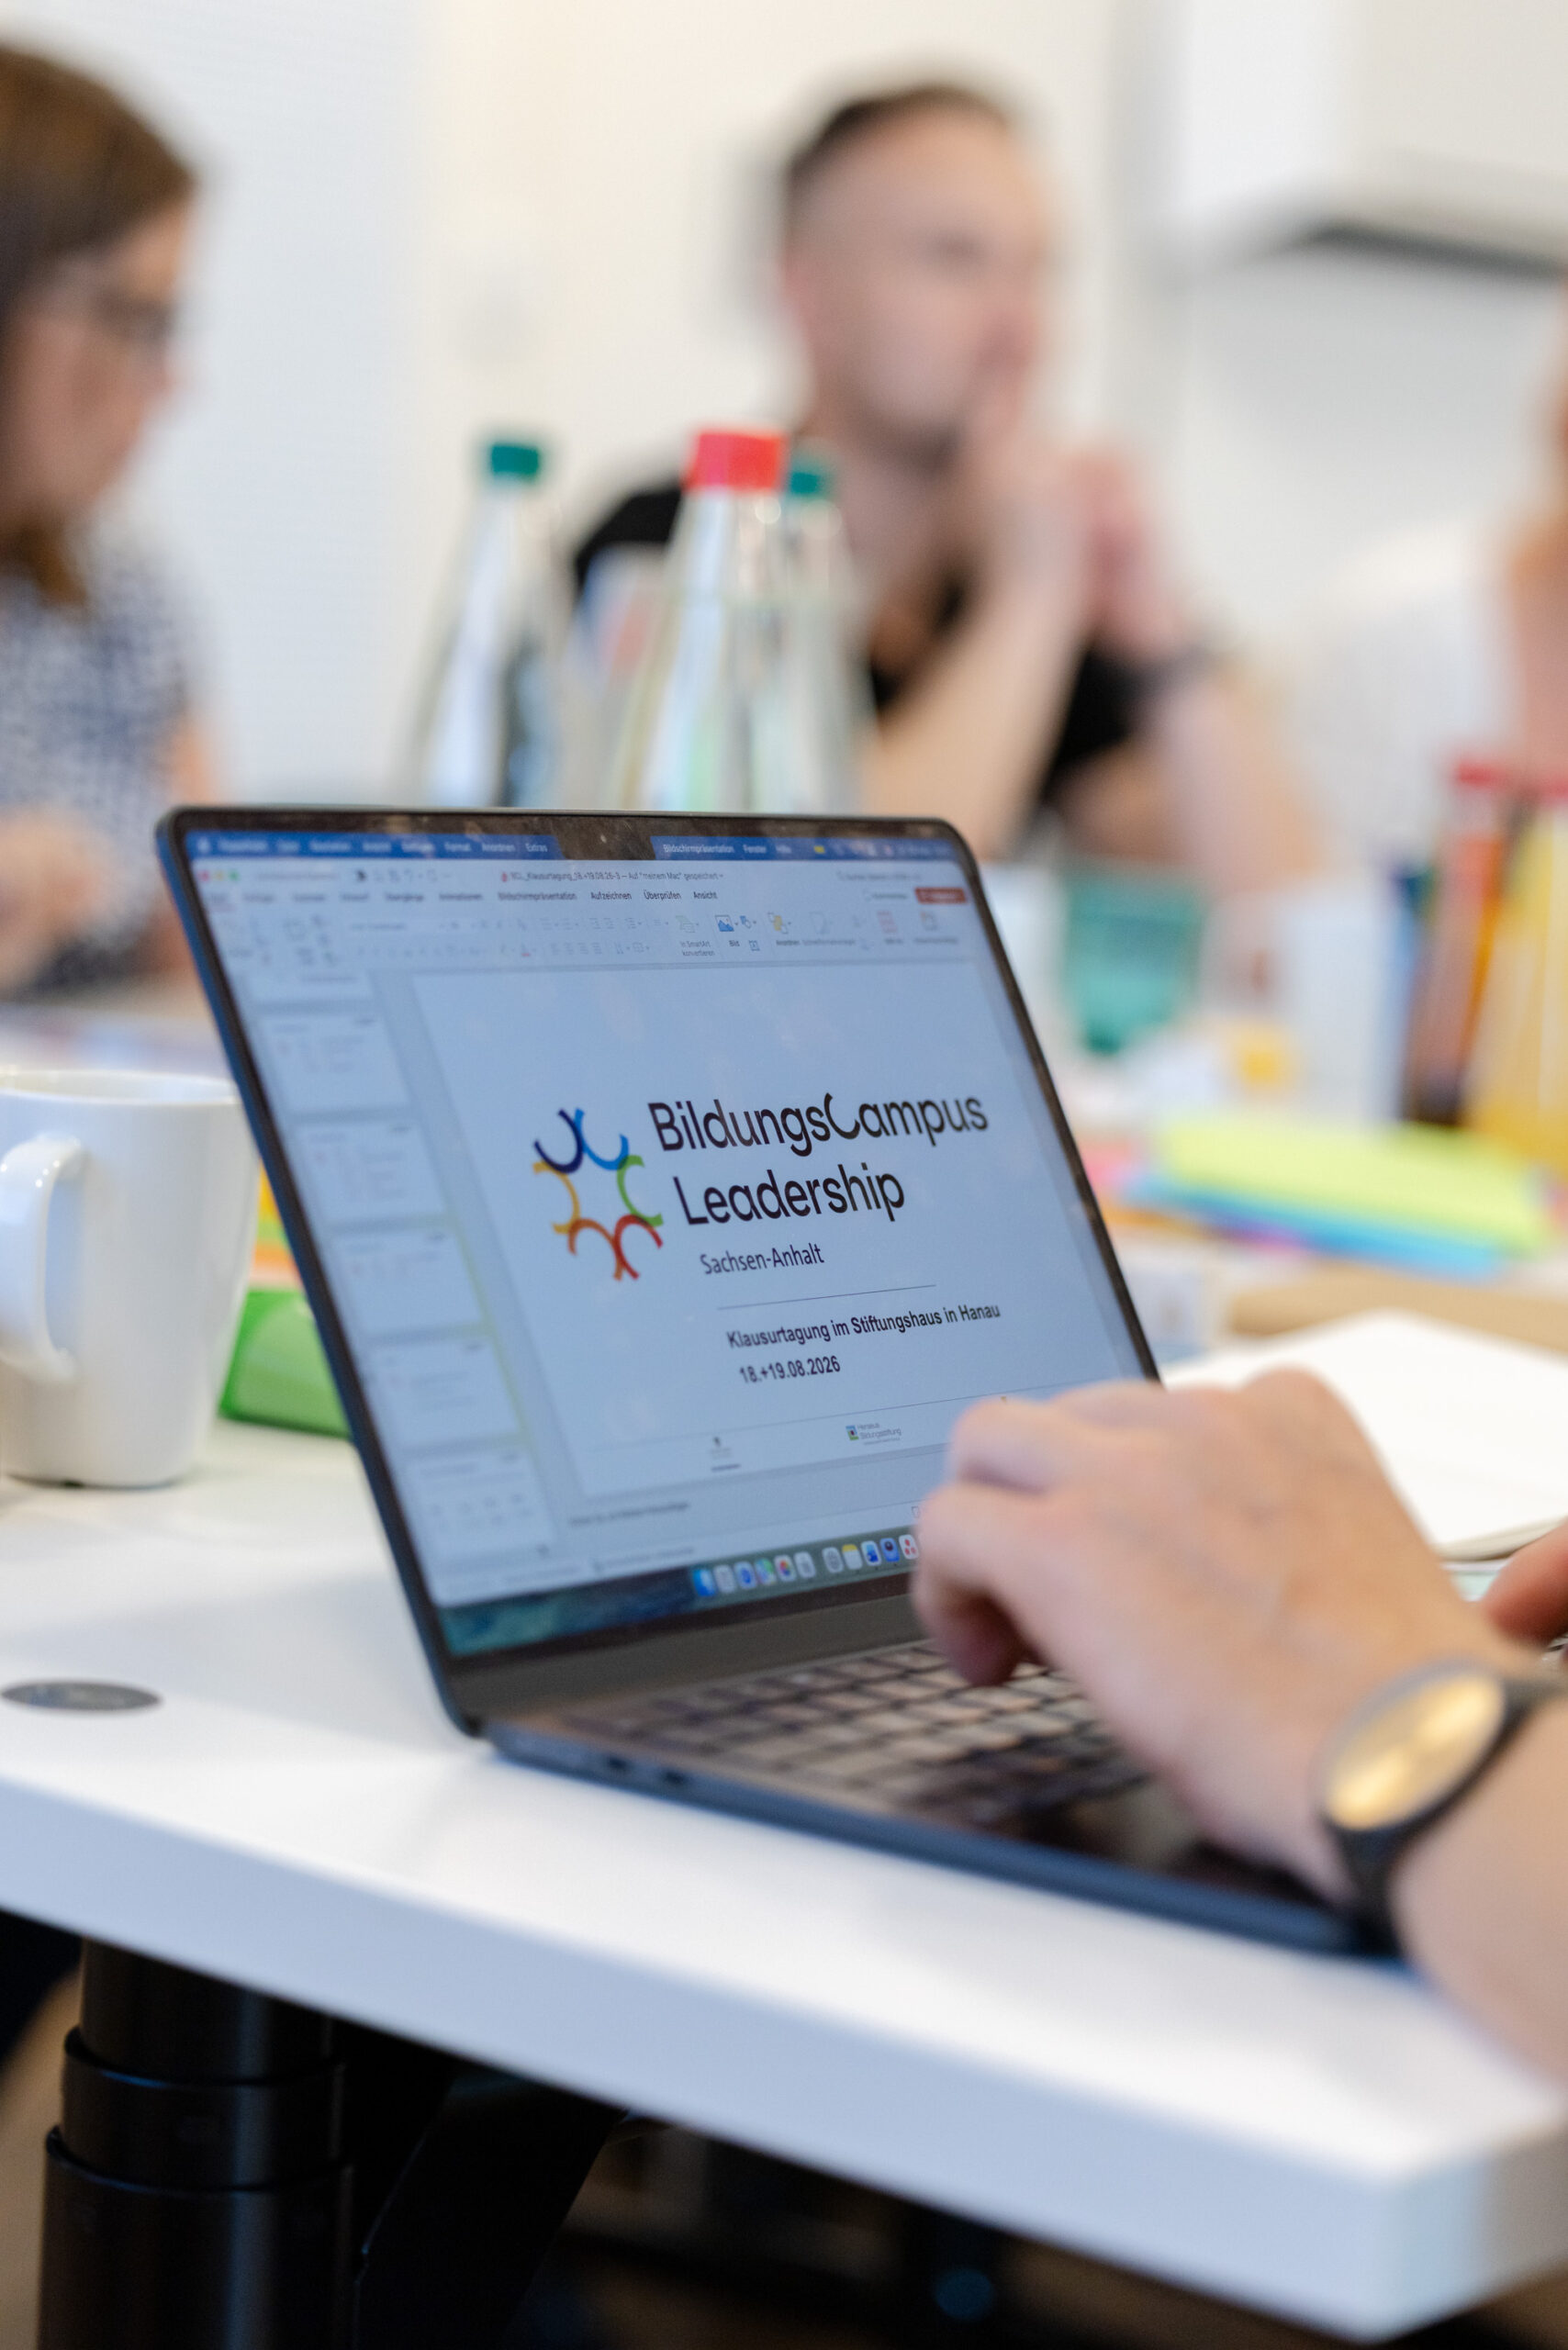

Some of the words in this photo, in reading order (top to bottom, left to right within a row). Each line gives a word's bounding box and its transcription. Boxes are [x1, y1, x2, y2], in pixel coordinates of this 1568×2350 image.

[525, 843, 548, 853] Extras
[590, 891, 633, 901] Aufzeichnen
[644, 890, 682, 901] Überprüfen
[693, 891, 718, 901] Ansicht
[648, 1093, 989, 1157] BildungsCampus
[673, 1162, 905, 1223] Leadership
[700, 1243, 824, 1275] Sachsen-Anhalt
[726, 1325, 831, 1348] Klausurtagung
[831, 1320, 850, 1337] im
[851, 1311, 943, 1333] Stiftungshaus
[944, 1307, 958, 1324] in
[958, 1304, 1001, 1322] Hanau
[739, 1355, 841, 1383] 18.+19.08.2026
